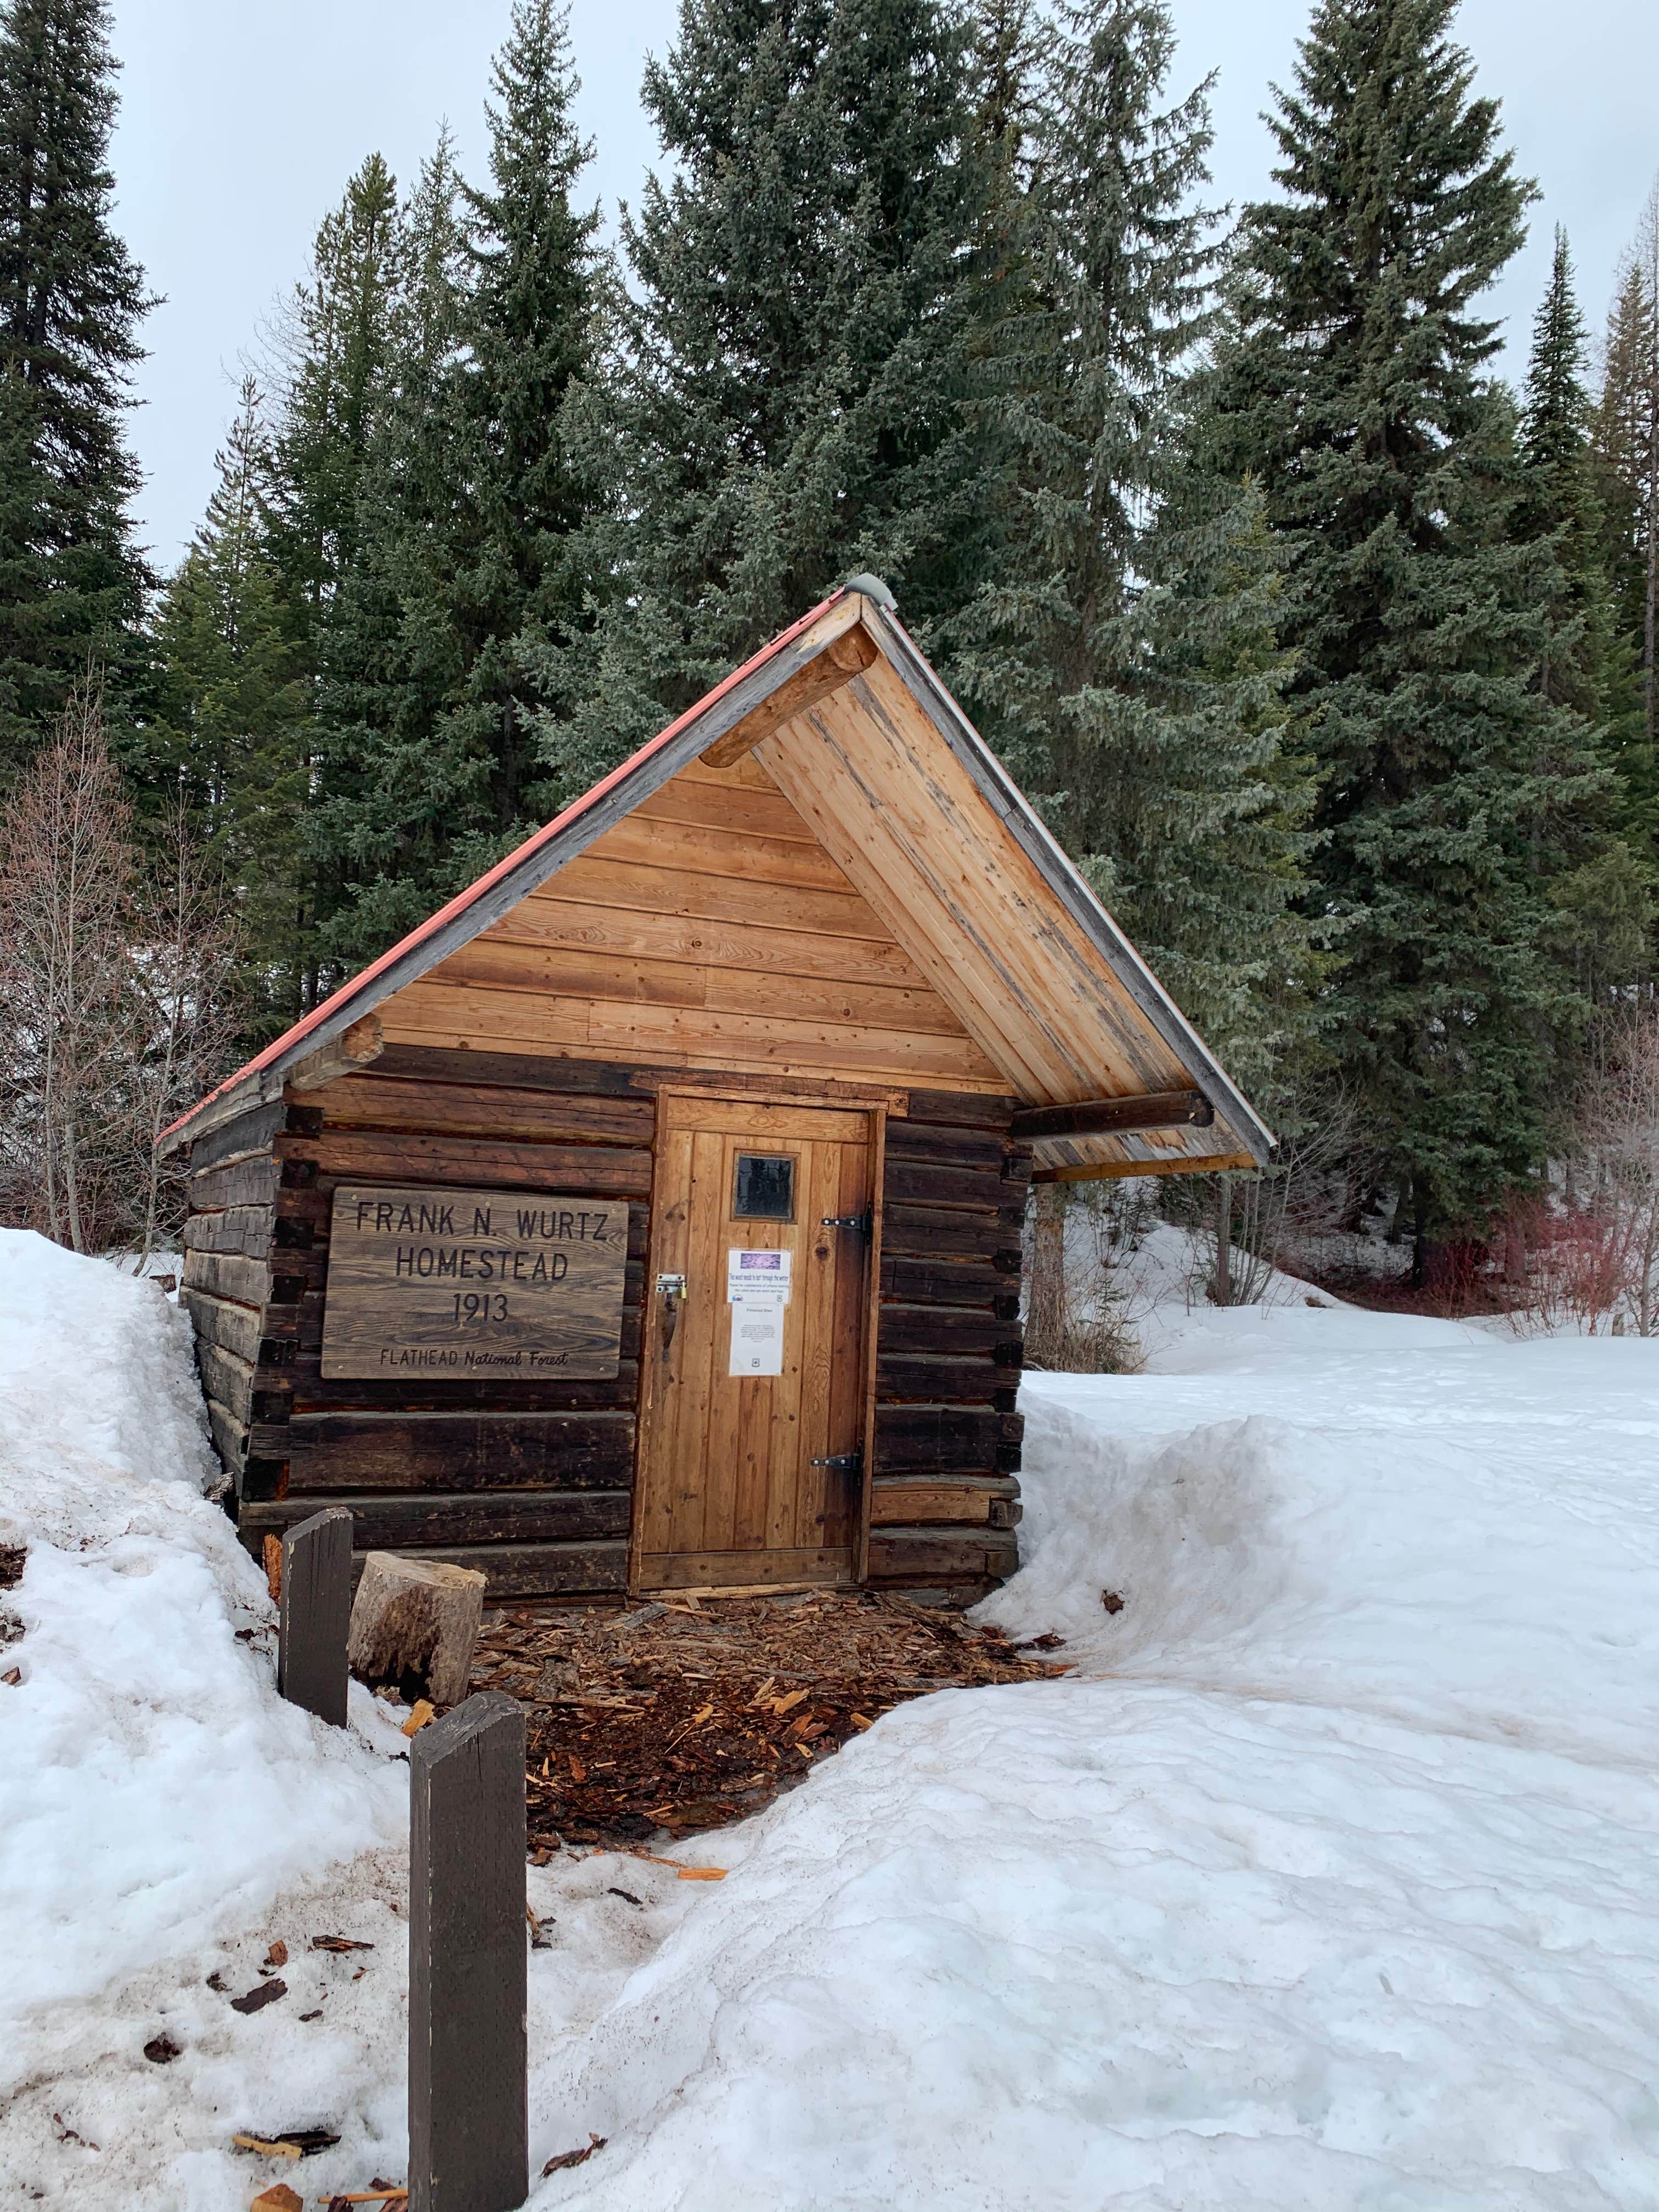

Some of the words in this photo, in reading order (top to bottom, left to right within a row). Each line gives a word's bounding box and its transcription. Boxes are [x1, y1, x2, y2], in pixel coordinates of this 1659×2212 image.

[357, 1201, 454, 1234] FRANK
[517, 1209, 608, 1240] WURTZ
[396, 1247, 568, 1281] HOMESTEAD
[453, 1293, 508, 1322] 1913
[380, 1348, 458, 1365] FLATHEAD
[464, 1351, 522, 1367] National
[529, 1352, 570, 1367] Forest
